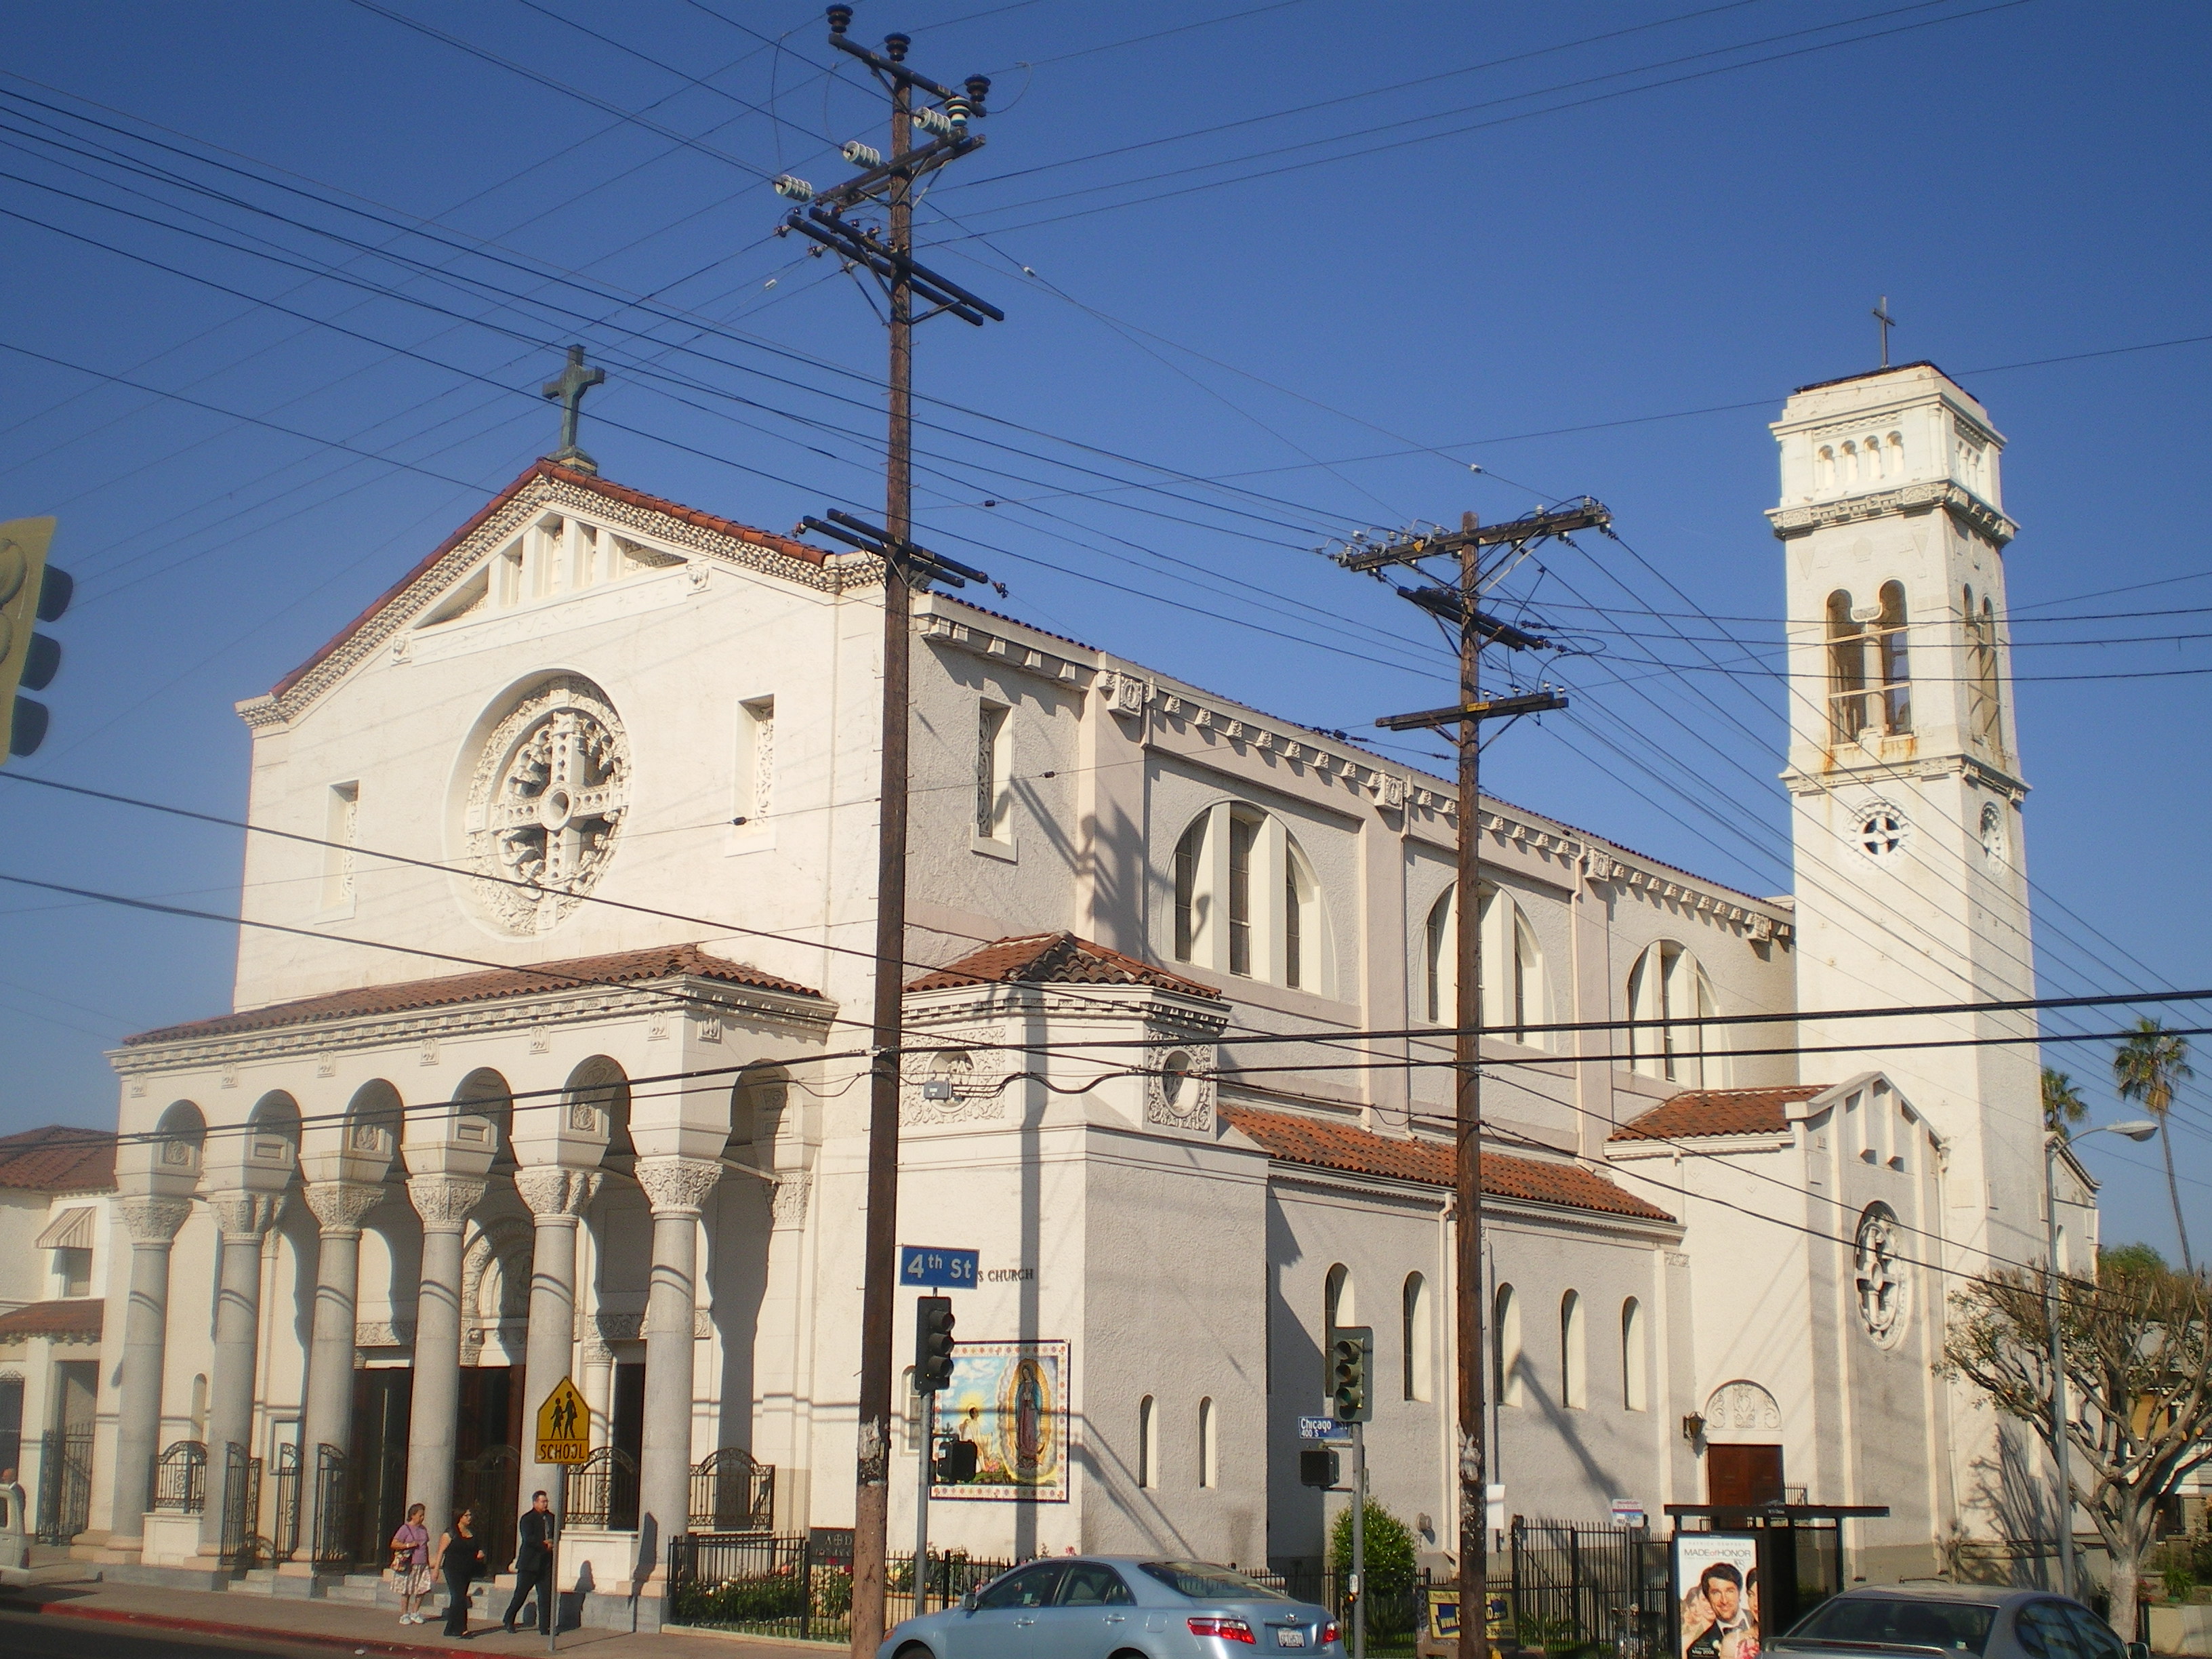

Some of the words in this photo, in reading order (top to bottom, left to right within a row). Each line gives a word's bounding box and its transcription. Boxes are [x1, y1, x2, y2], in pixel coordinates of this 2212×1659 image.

[907, 1254, 943, 1279] 4th
[950, 1258, 972, 1279] St
[987, 1268, 1034, 1283] CHURCH
[1300, 1418, 1332, 1434] Chicago
[1300, 1429, 1313, 1437] 400
[1314, 1429, 1319, 1437] S
[540, 1443, 584, 1460] SCHOOL
